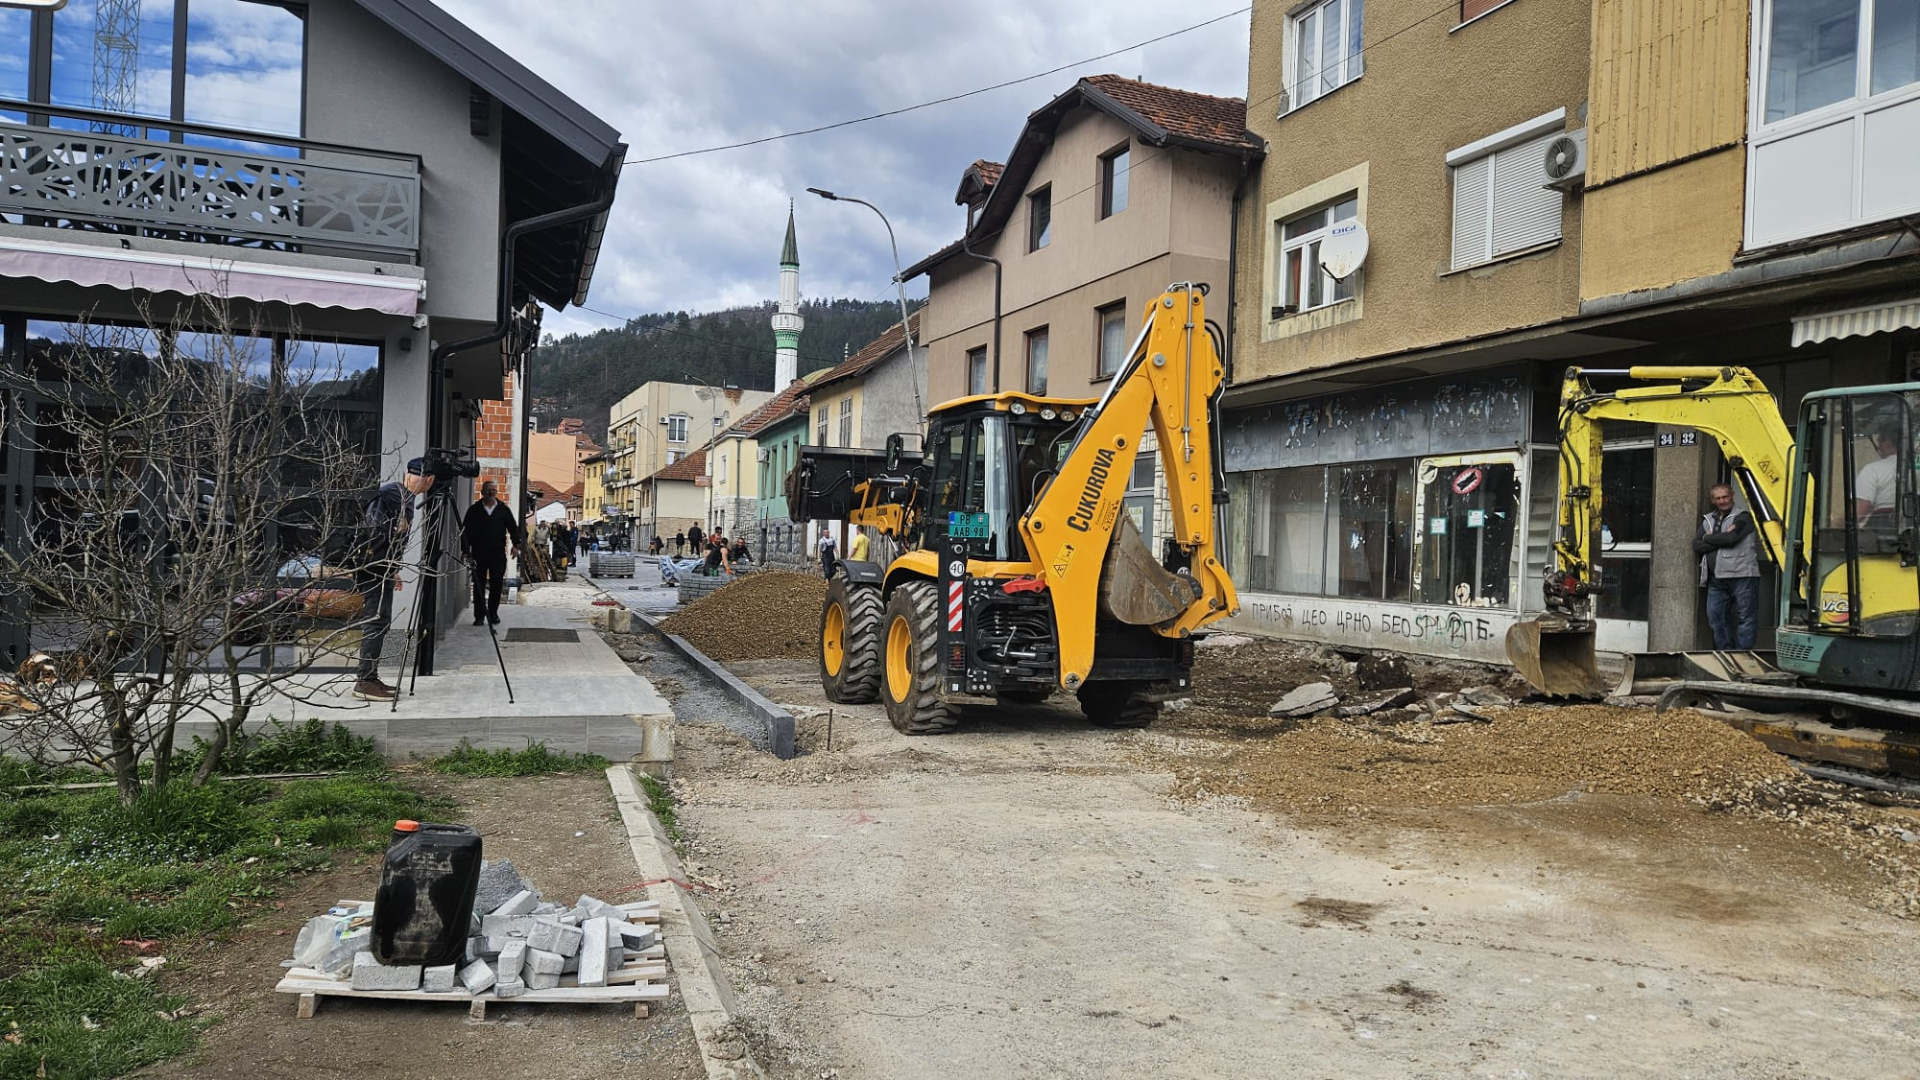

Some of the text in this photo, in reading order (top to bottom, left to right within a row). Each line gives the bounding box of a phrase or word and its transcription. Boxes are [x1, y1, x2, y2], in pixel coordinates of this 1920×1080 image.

[1661, 434, 1673, 446] 34
[1682, 432, 1695, 444] 32
[950, 563, 964, 575] 40
[1302, 609, 1327, 631] ЦЕО
[1337, 610, 1371, 634] ЦРНО
